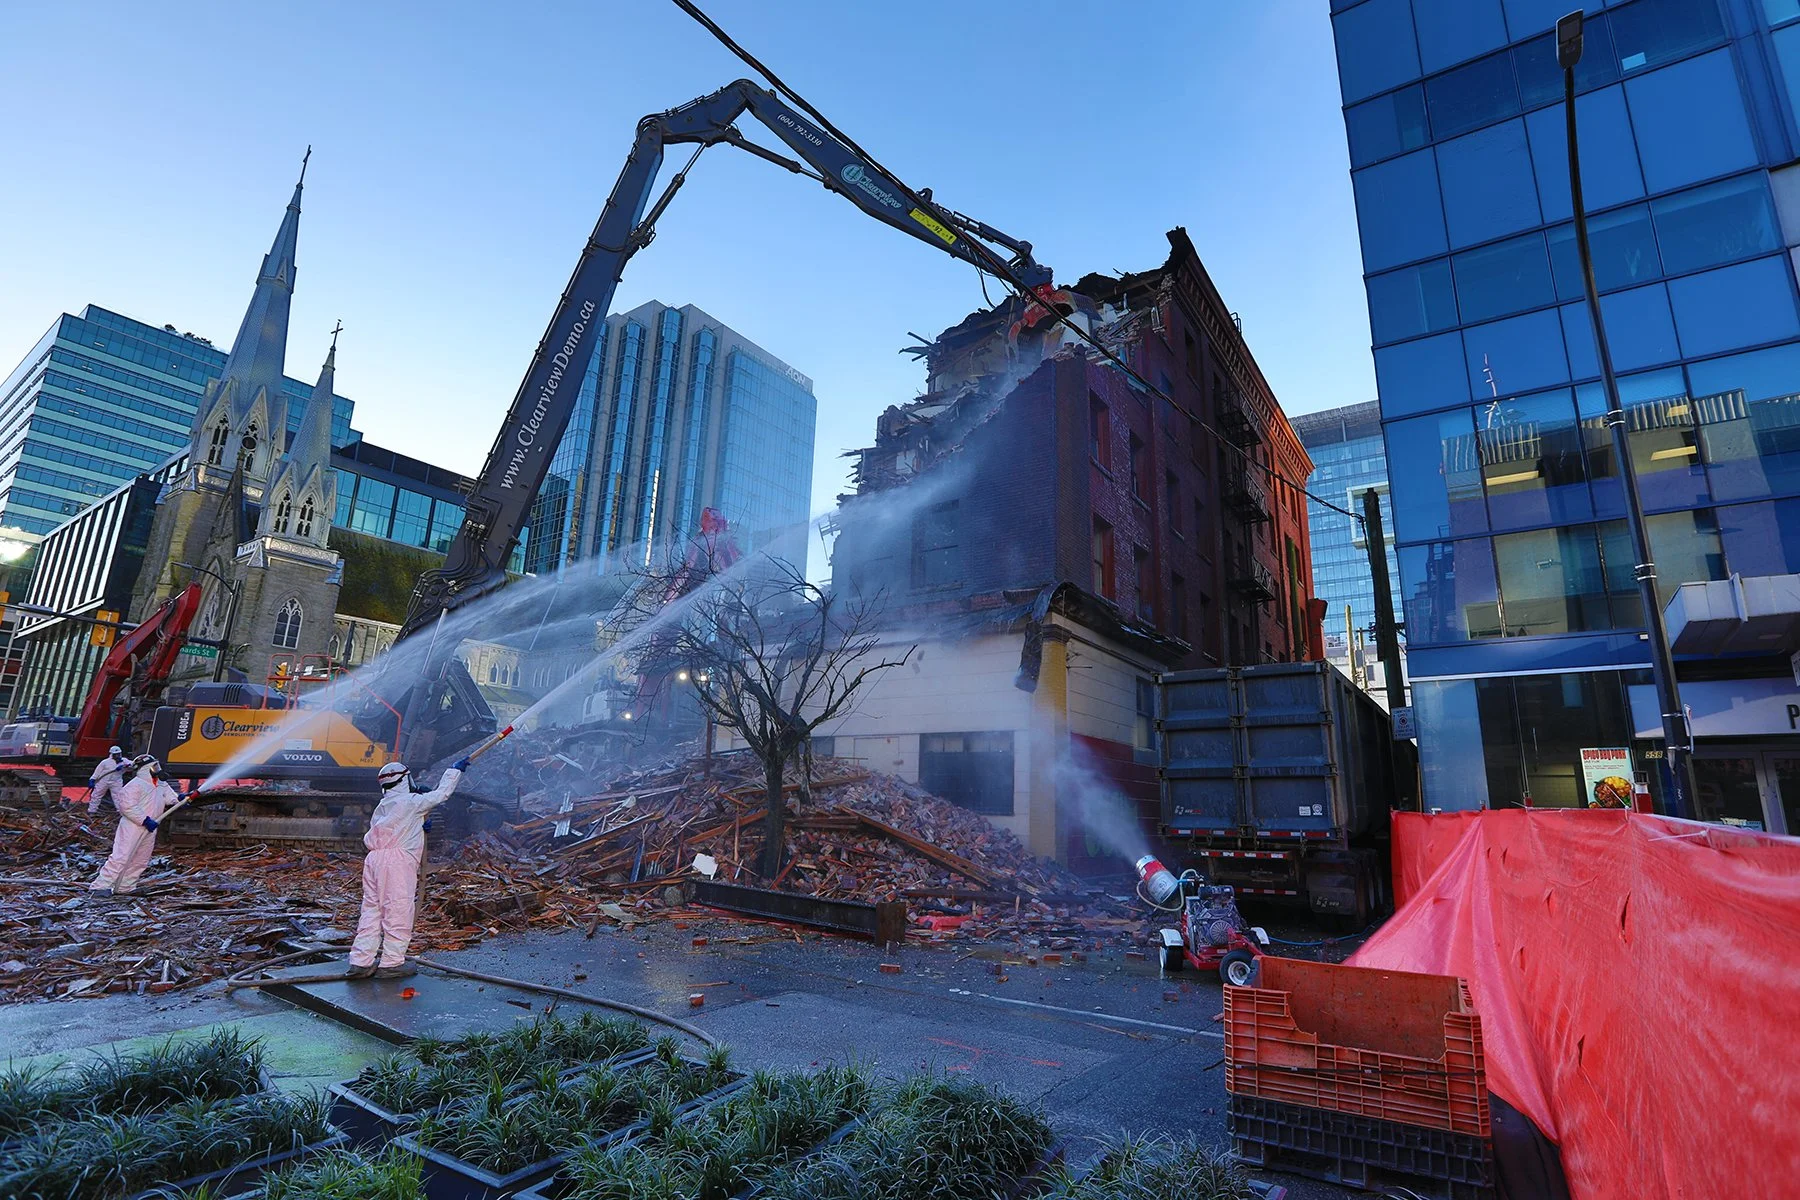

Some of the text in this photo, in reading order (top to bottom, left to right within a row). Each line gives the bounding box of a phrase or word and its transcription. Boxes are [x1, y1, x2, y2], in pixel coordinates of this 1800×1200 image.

[777, 113, 823, 147] (604) 792-3330
[858, 175, 902, 209] Clearview
[785, 366, 806, 385] AON
[501, 300, 595, 489] www.ClearviewDemo.ca
[222, 721, 280, 732] Clearview
[282, 753, 323, 762] VOLVO
